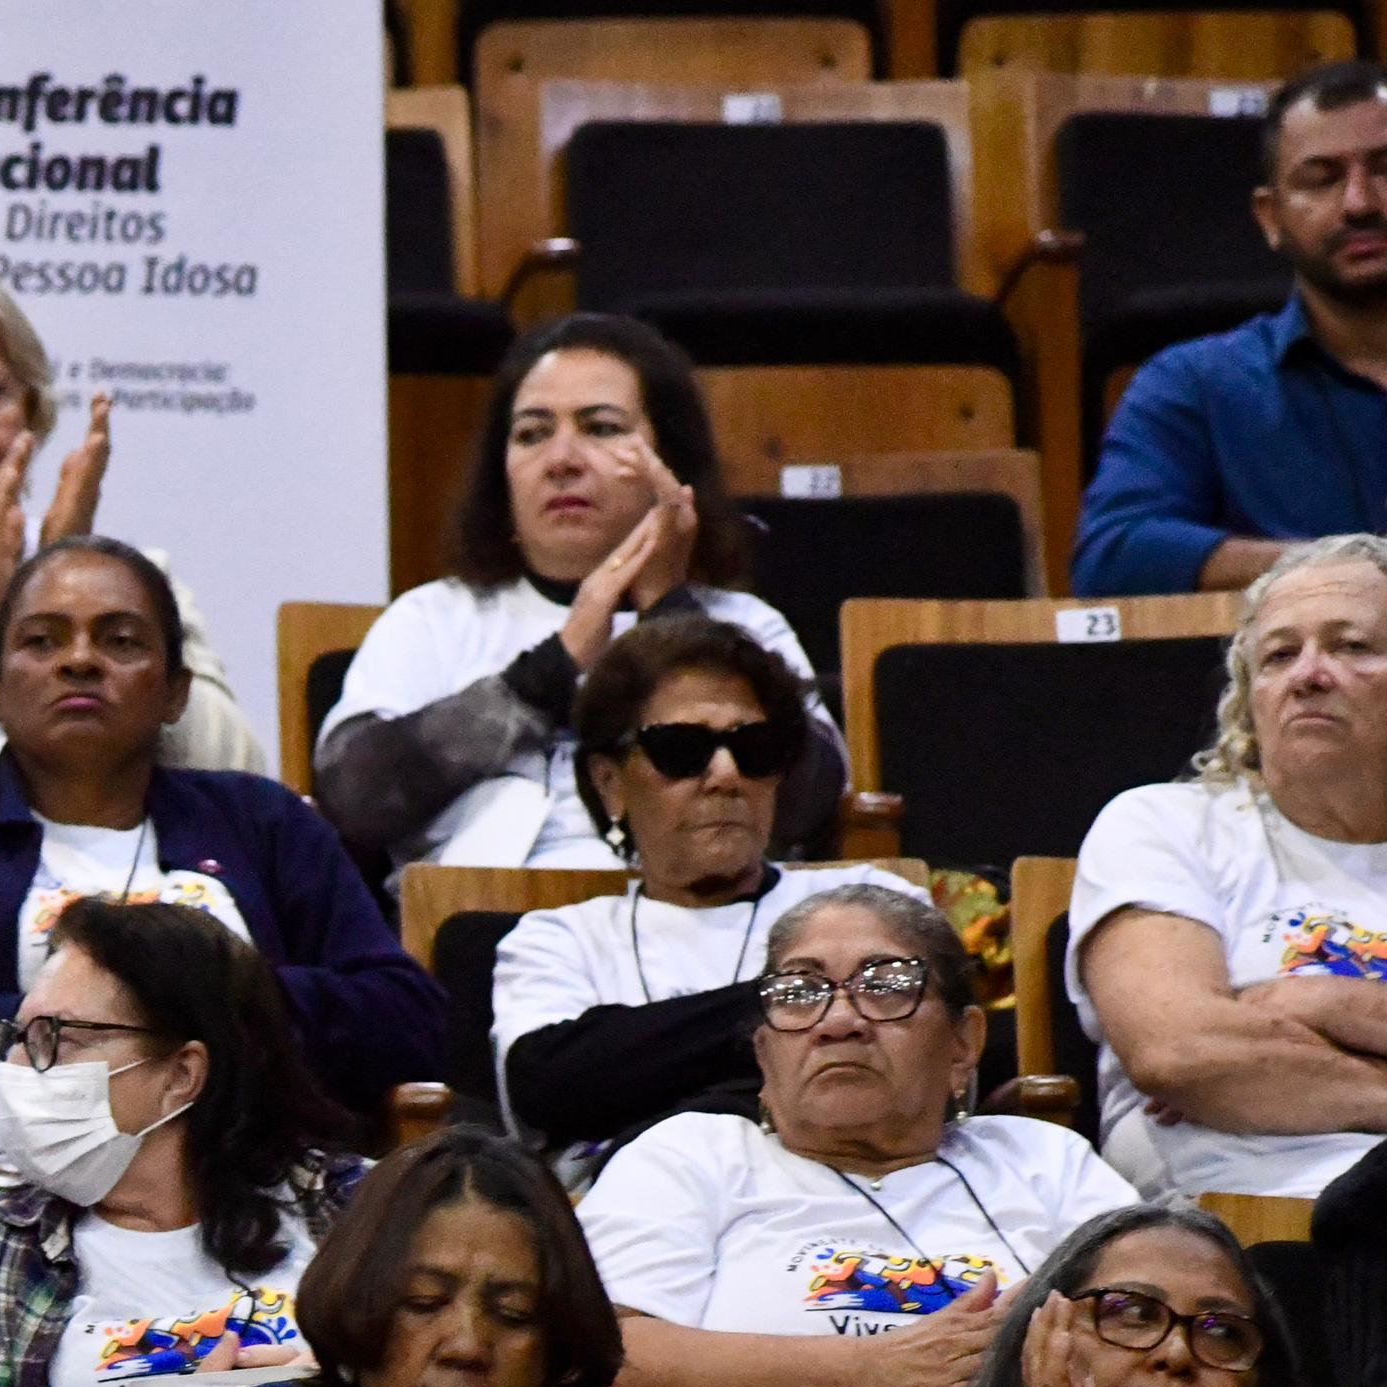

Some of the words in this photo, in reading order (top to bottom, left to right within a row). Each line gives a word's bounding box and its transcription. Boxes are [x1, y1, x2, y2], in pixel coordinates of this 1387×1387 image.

[5, 200, 167, 243] Direitos
[139, 253, 259, 296] Idosa
[1087, 614, 1116, 636] 23
